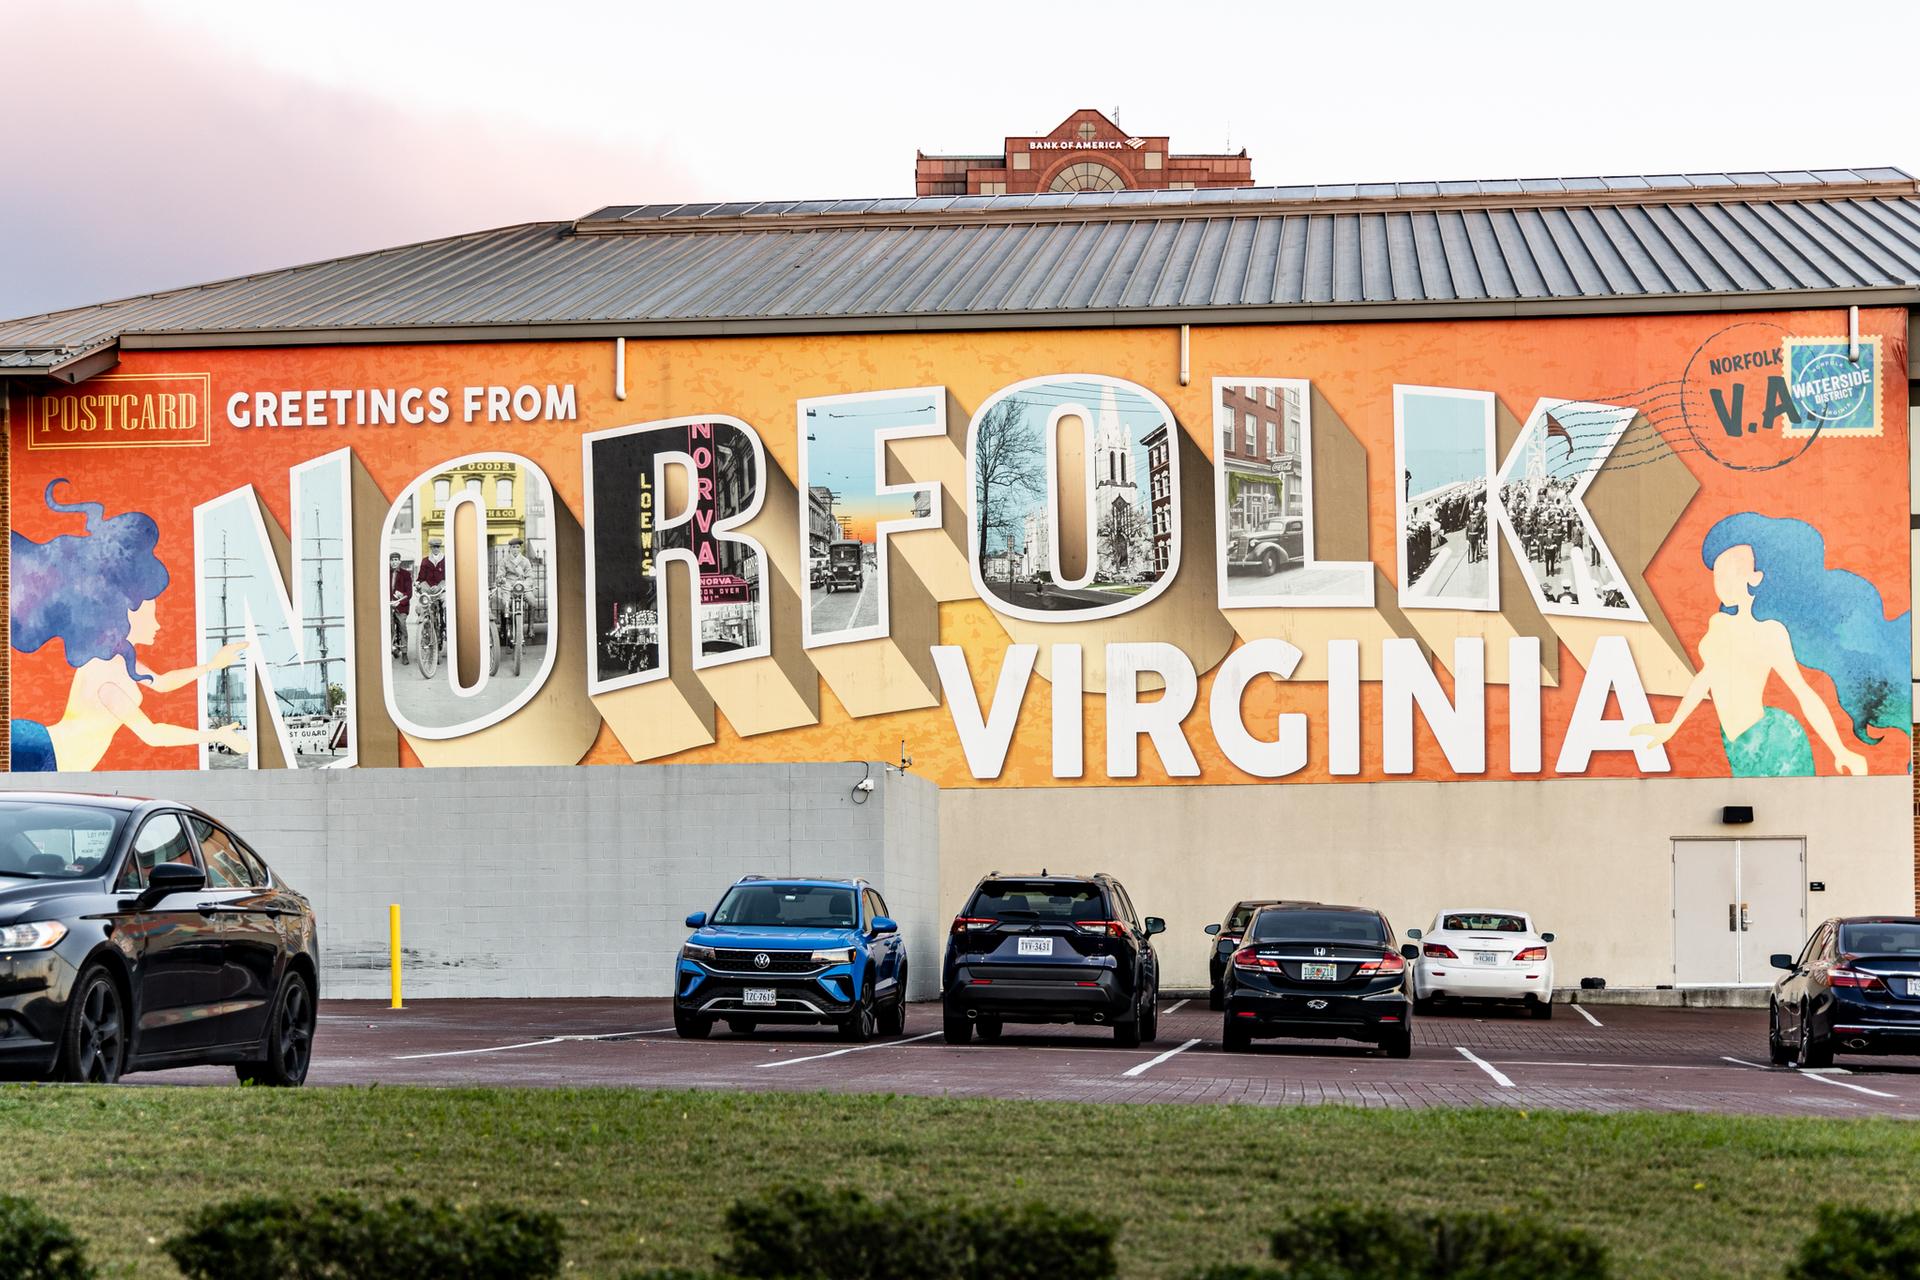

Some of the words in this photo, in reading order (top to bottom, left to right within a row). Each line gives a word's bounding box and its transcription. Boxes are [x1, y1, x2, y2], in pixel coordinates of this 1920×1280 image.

[1030, 141, 1058, 150] BANK
[1060, 141, 1073, 150] OF
[1076, 141, 1122, 150] AMERICA
[1709, 348, 1784, 376] NORFOLK
[1792, 369, 1872, 399] WATERSIDE
[1814, 387, 1854, 404] DISTRICT
[41, 393, 197, 432] POSTCARD
[226, 386, 450, 428] GREETINGS
[464, 384, 577, 423] FROM
[691, 423, 716, 566] NORVA
[194, 372, 1650, 770] NORFOLK
[930, 635, 1671, 779] VIRGINIA
[301, 729, 327, 738] GUARD
